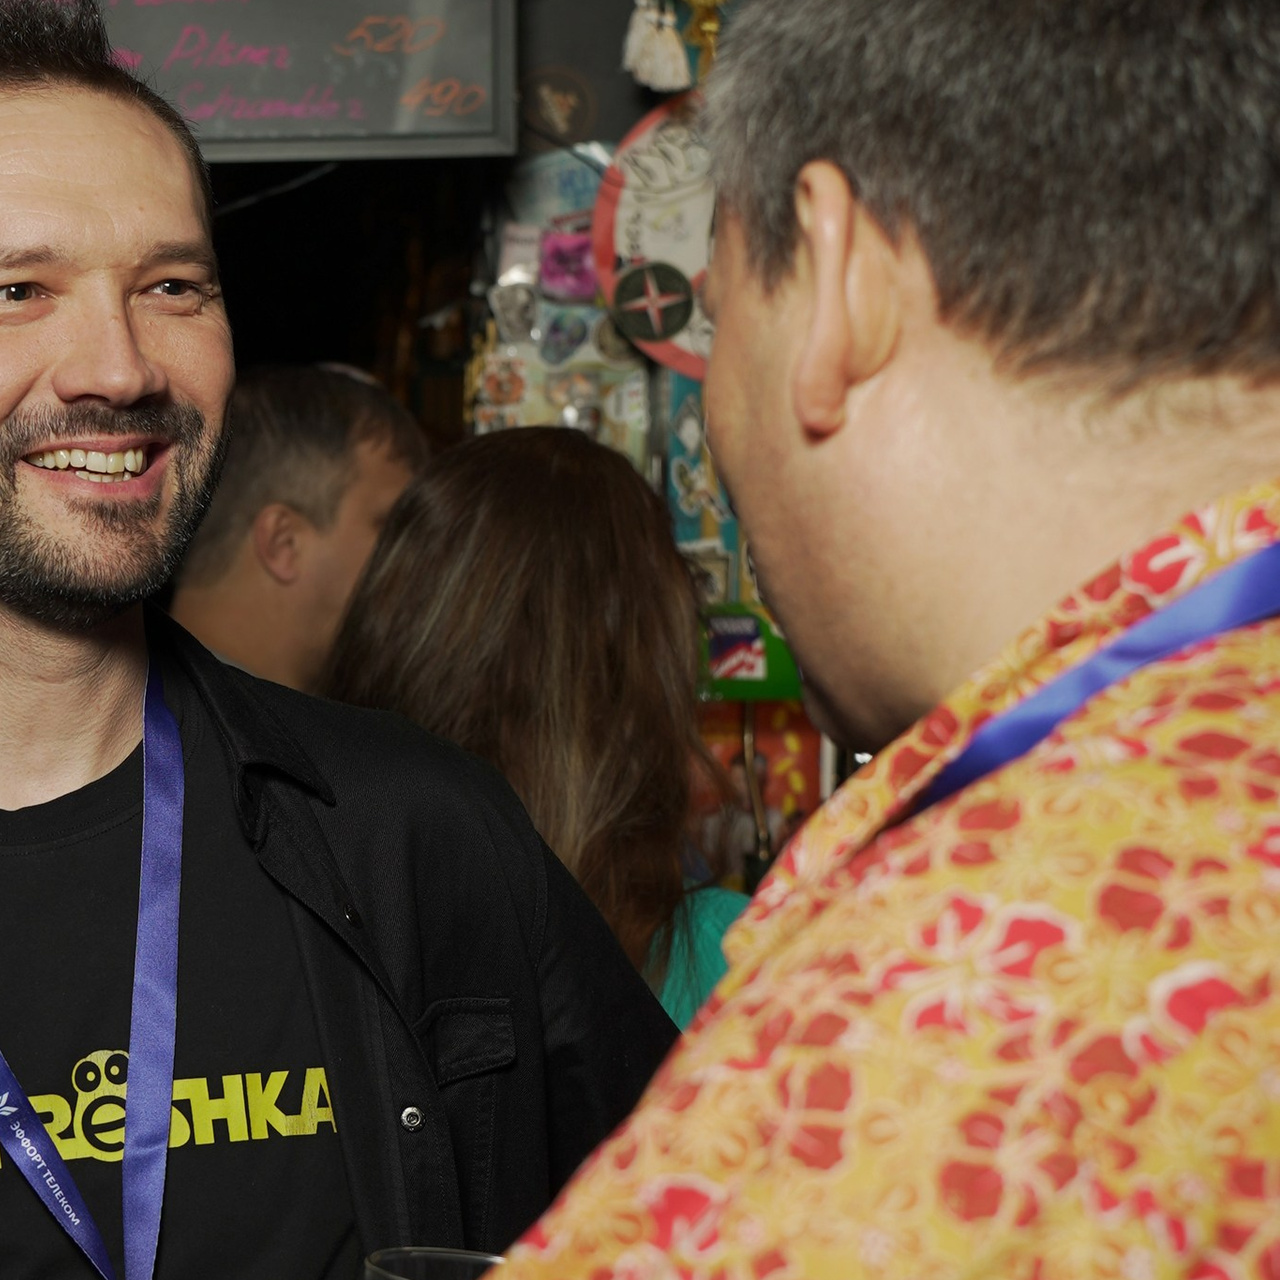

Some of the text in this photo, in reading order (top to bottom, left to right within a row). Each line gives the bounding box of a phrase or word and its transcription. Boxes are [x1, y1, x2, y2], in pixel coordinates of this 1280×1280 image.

[400, 78, 486, 118] 490
[10, 1121, 81, 1226] ЭФФОРТ ТЕЛЕКОМ
